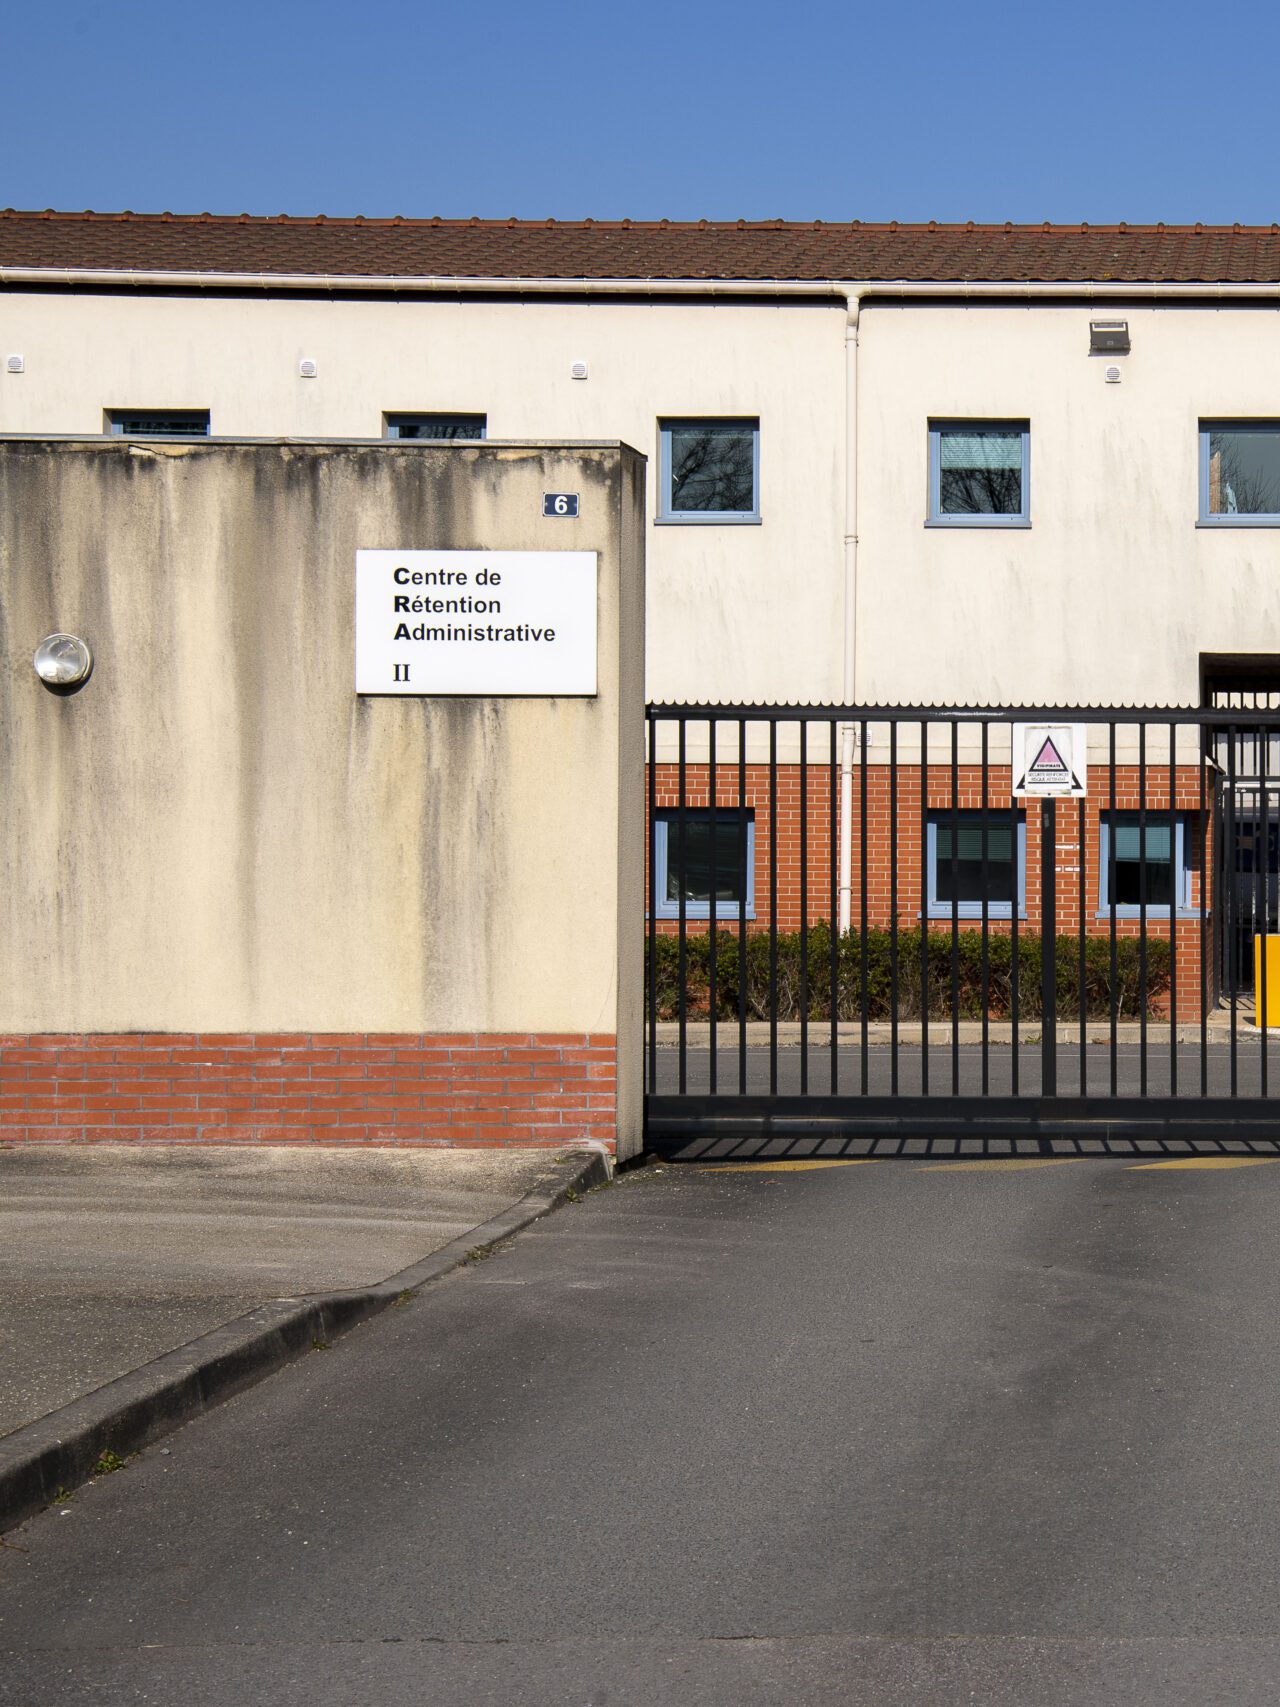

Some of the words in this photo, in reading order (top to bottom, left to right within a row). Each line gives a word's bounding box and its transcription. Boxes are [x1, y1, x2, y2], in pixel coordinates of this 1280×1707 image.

[554, 495, 569, 514] 6
[393, 567, 468, 585] Centre
[475, 568, 502, 585] de
[394, 595, 501, 614] Rétention
[393, 622, 556, 642] Administrative
[392, 663, 411, 682] II
